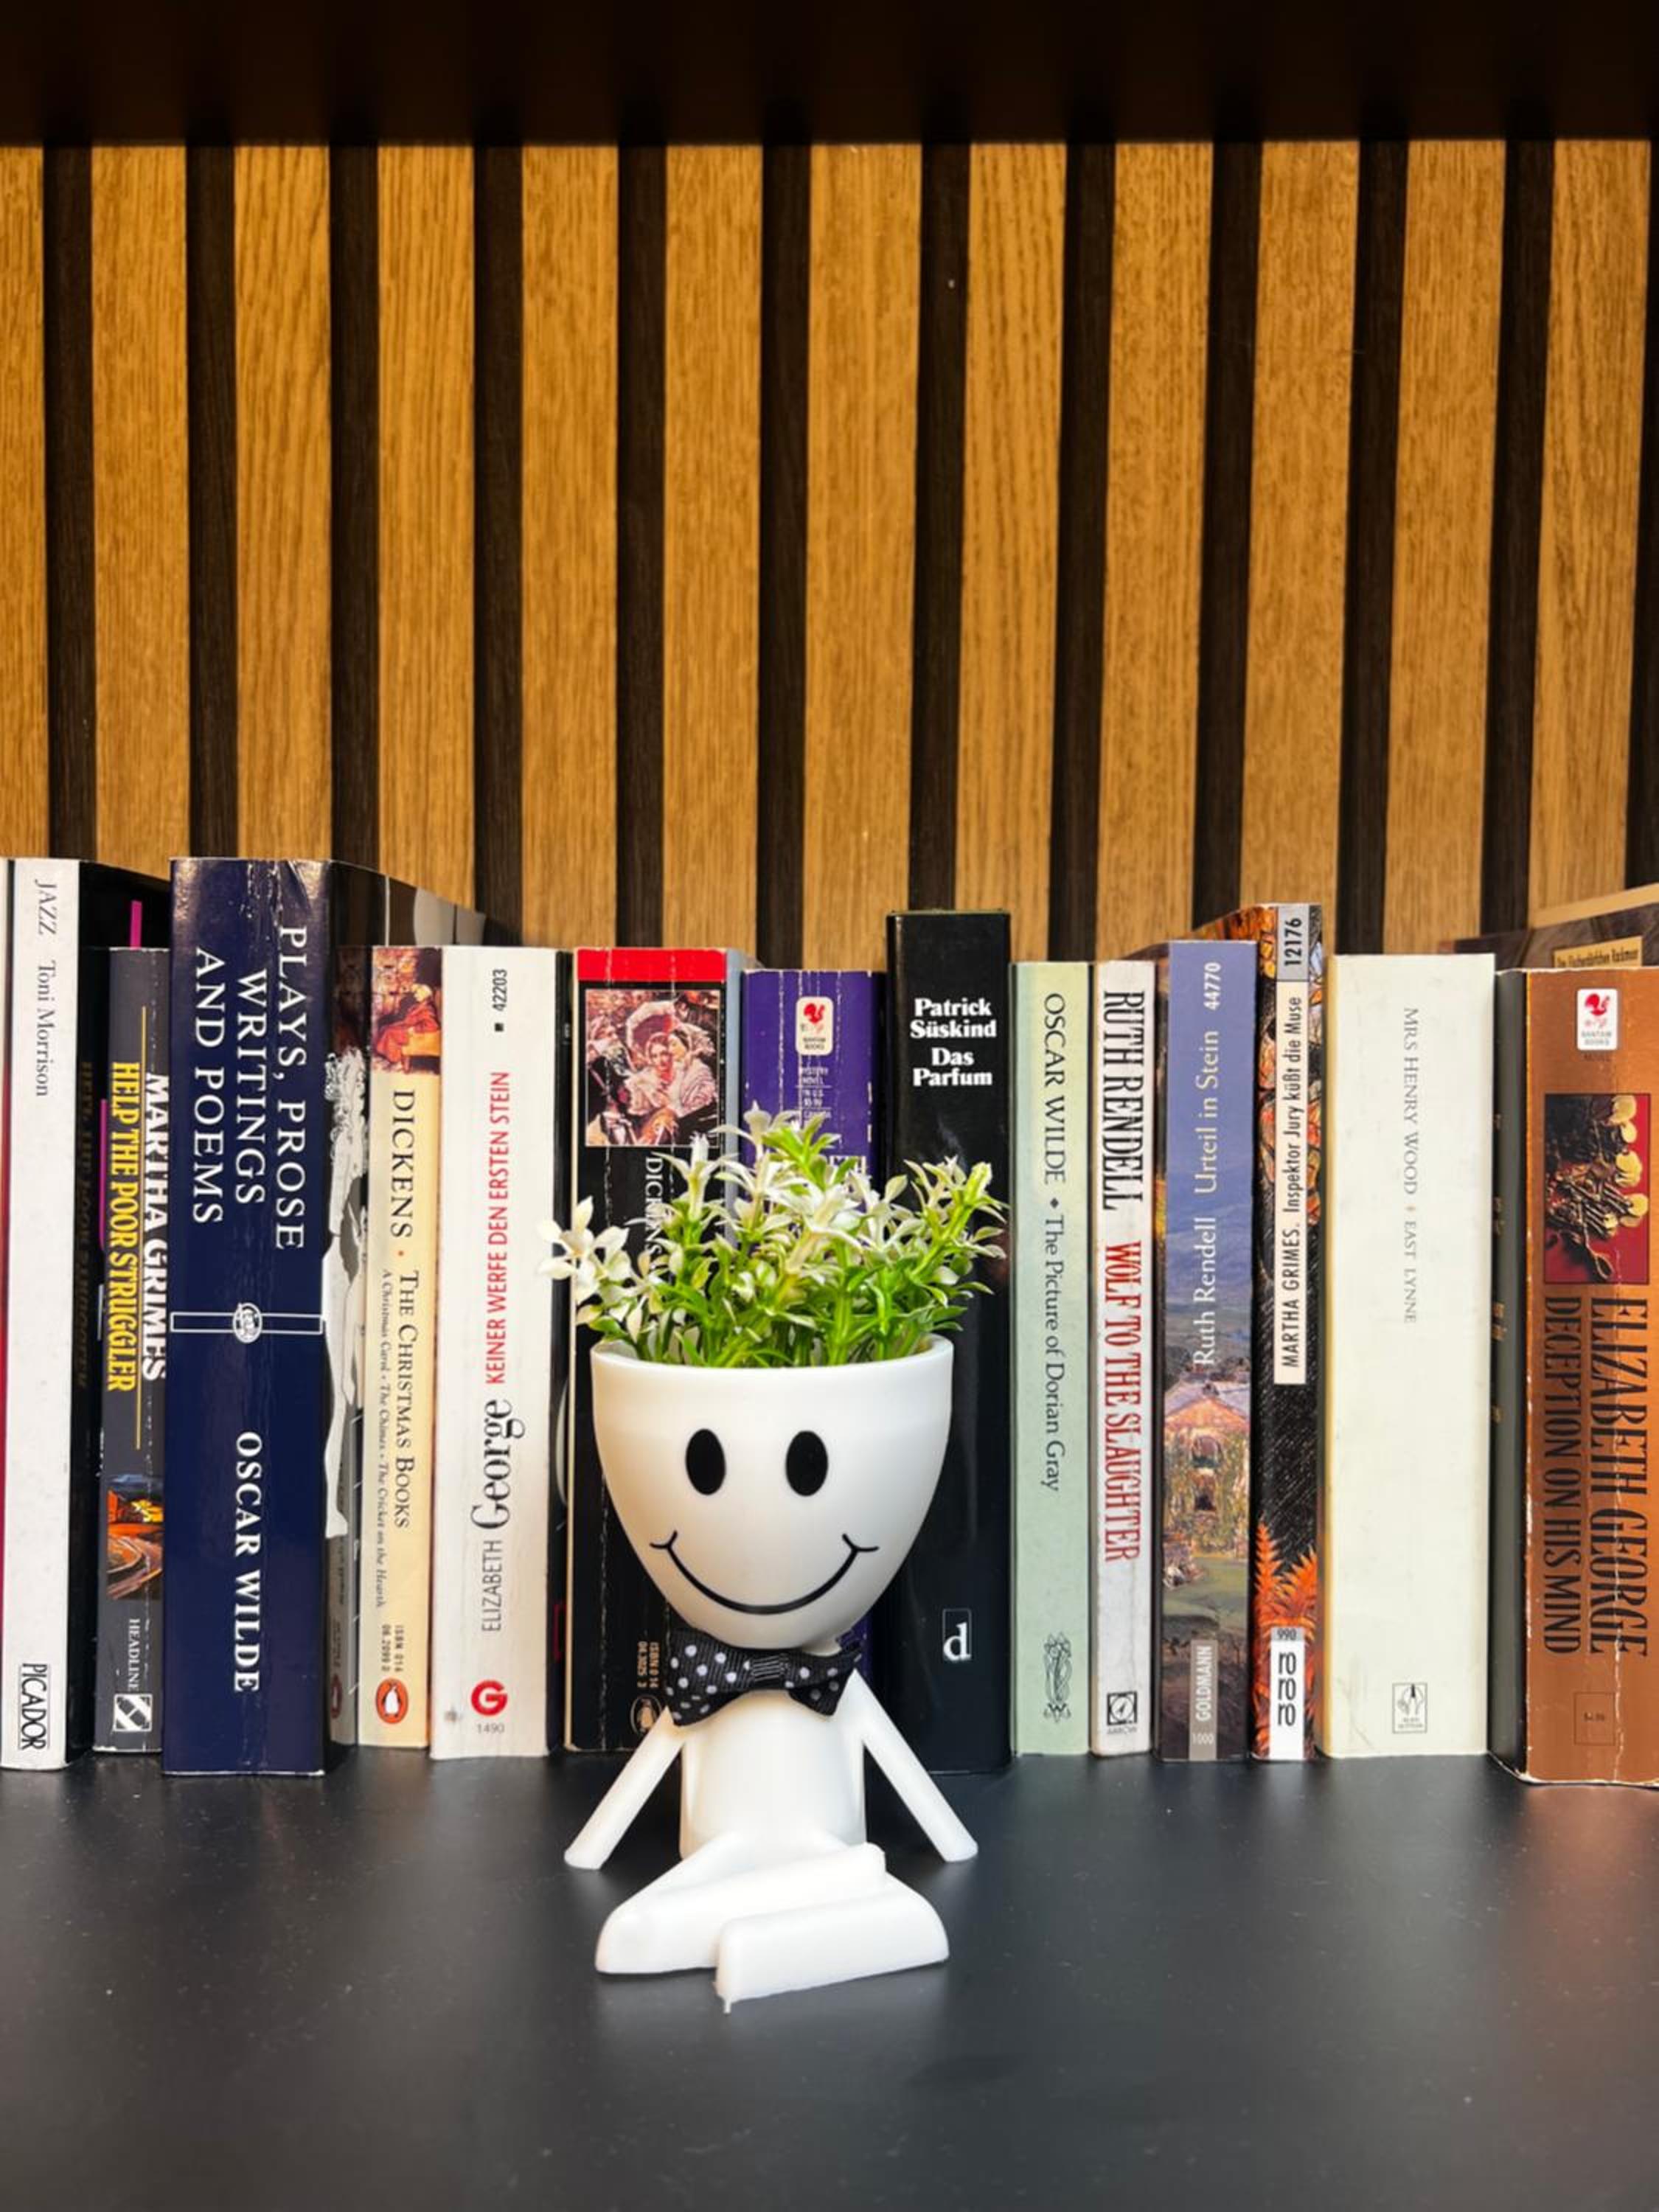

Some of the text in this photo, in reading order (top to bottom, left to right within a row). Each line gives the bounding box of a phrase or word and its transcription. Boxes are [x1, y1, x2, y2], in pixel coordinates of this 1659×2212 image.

[1203, 961, 1221, 1011] 44770
[1284, 917, 1302, 966] 12176
[35, 880, 57, 1097] JAZZ Toni Morrison
[492, 969, 508, 1011] 42203
[910, 1018, 997, 1039] Süskind
[914, 998, 992, 1018] Patrick
[192, 947, 225, 1224] AND POEMS
[236, 969, 267, 1204] WRITINGS
[274, 927, 307, 1249] PLAYS, PROSE
[912, 1068, 993, 1088] Parfum
[931, 1046, 975, 1067] Das
[1043, 992, 1065, 1186] OSCAR WILDE
[1102, 991, 1144, 1211] RUTH RENDELL
[1402, 1008, 1419, 1195] MRS HENRY WOOD
[390, 1090, 414, 1239] DICKENS
[644, 1156, 664, 1253] DICNS
[1193, 1029, 1219, 1366] Ruth Rendell Urteil in Stein
[1281, 997, 1304, 1369] MARTHA GRIMES. Inspektor Jury küßt die Muse
[108, 1062, 140, 1391] HELP THE POOR STRUGGLER
[142, 1073, 170, 1381] MARTHA GRIMES
[1403, 1220, 1416, 1324] EAST LYNNE
[380, 1281, 392, 1338] Christmas
[470, 1072, 526, 1632] ELIZABETH George KEINER WERFE DEN ERSTEN STEIN
[1040, 1215, 1065, 1492] The Picture of Dorian Gray
[378, 1384, 390, 1407] The
[394, 1270, 419, 1528] THE CHRISTMAS BOOKS
[1104, 1241, 1142, 1562] WOLF TO THE SLAUGHTER
[378, 1461, 389, 1485] The
[1543, 1297, 1582, 1654] DECEPTION ON HIS MIND
[1589, 1297, 1648, 1658] ELIZABETH GEORGE
[234, 1431, 262, 1693] OSCAR WILDE
[127, 1618, 141, 1692] HEADLINE
[943, 1621, 971, 1661] d
[1276, 1628, 1297, 1641] 990
[1278, 1650, 1297, 1676] ro
[21, 1663, 47, 1750] PICADOR
[470, 1680, 508, 1717] G
[478, 1723, 505, 1734] 1490
[1195, 1645, 1212, 1722] GOLDMANN
[1277, 1702, 1296, 1727] ro
[1278, 1677, 1296, 1701] ro
[1192, 1733, 1214, 1745] 1000
